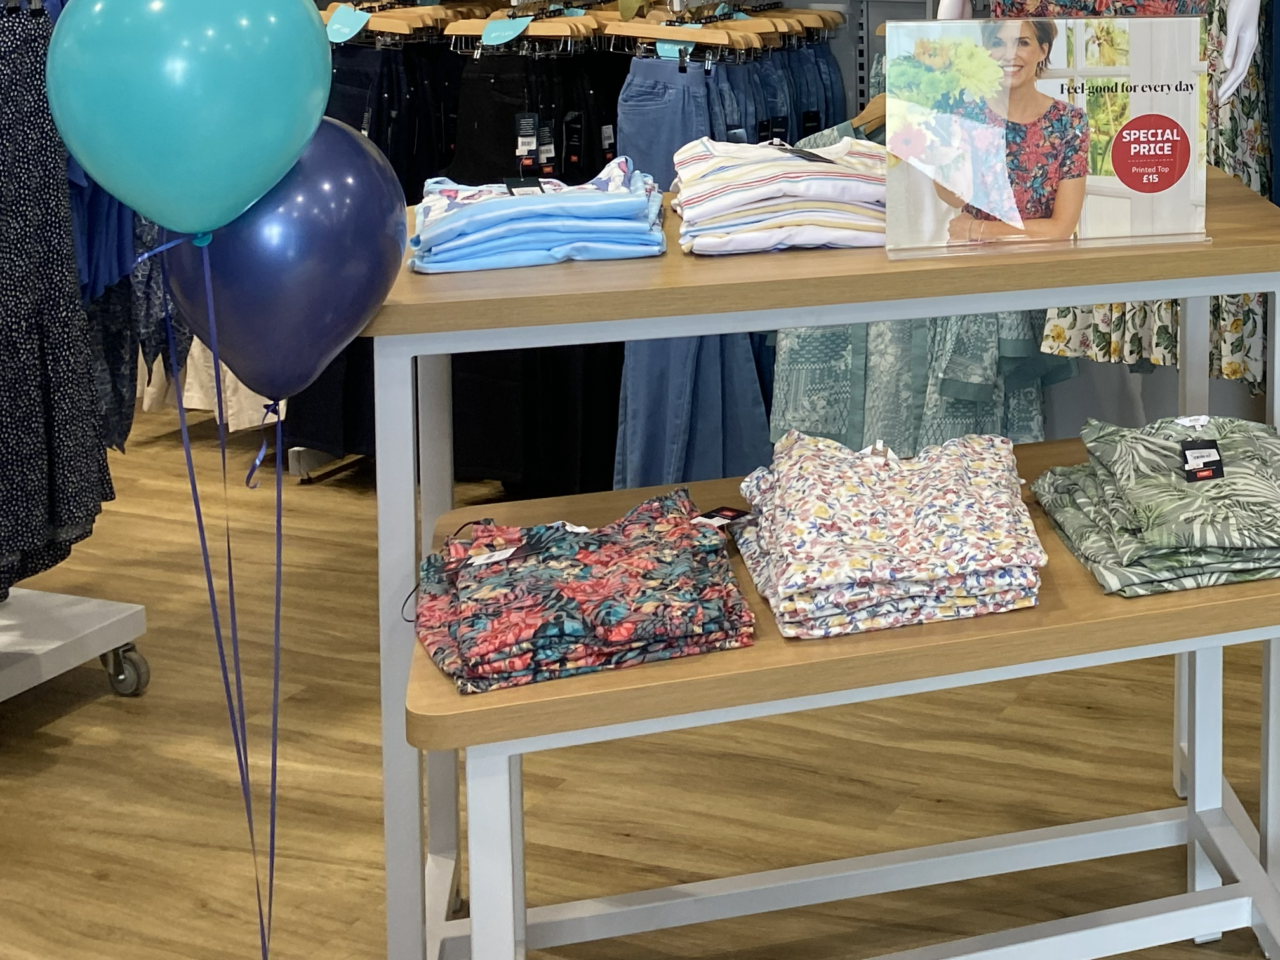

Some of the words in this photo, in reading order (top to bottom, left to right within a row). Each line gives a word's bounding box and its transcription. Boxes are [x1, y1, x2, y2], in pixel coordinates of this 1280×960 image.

[1060, 82, 1118, 96] Feel-good
[1121, 82, 1139, 93] for
[1141, 84, 1172, 95] every
[1175, 81, 1196, 94] day
[1122, 129, 1180, 142] SPECIAL
[1130, 143, 1172, 155] PRICE
[1142, 174, 1158, 182] £15
